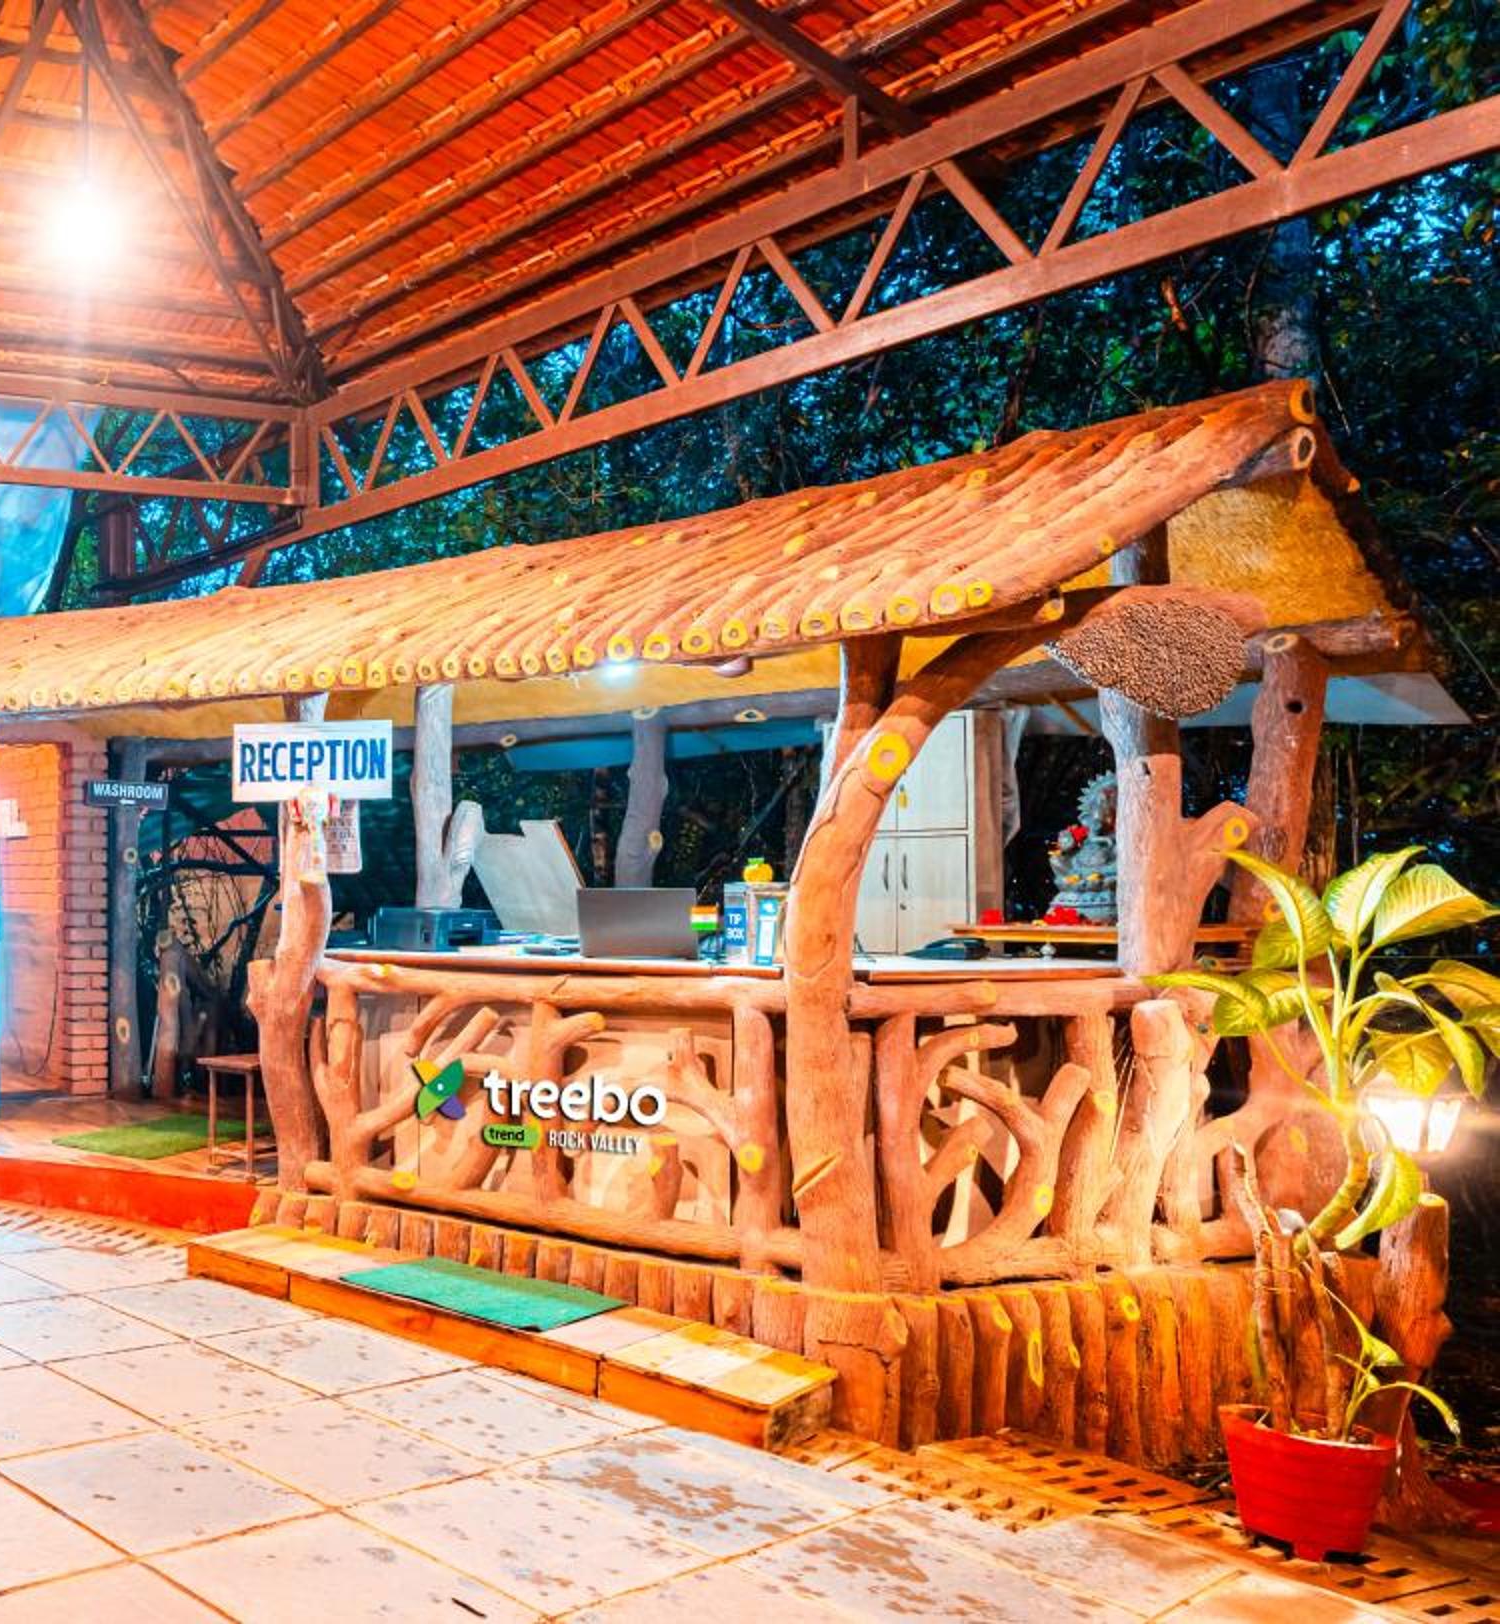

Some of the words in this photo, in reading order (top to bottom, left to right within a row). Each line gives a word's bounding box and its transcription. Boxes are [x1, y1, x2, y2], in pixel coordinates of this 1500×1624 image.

[239, 738, 387, 783] RECEPTION
[93, 782, 164, 800] WASHROOM
[728, 913, 742, 925] TIP
[726, 927, 745, 941] BOX
[483, 1069, 667, 1125] treebo
[488, 1126, 526, 1143] trend
[548, 1130, 586, 1150] ROCK
[589, 1132, 644, 1155] VALLEY
